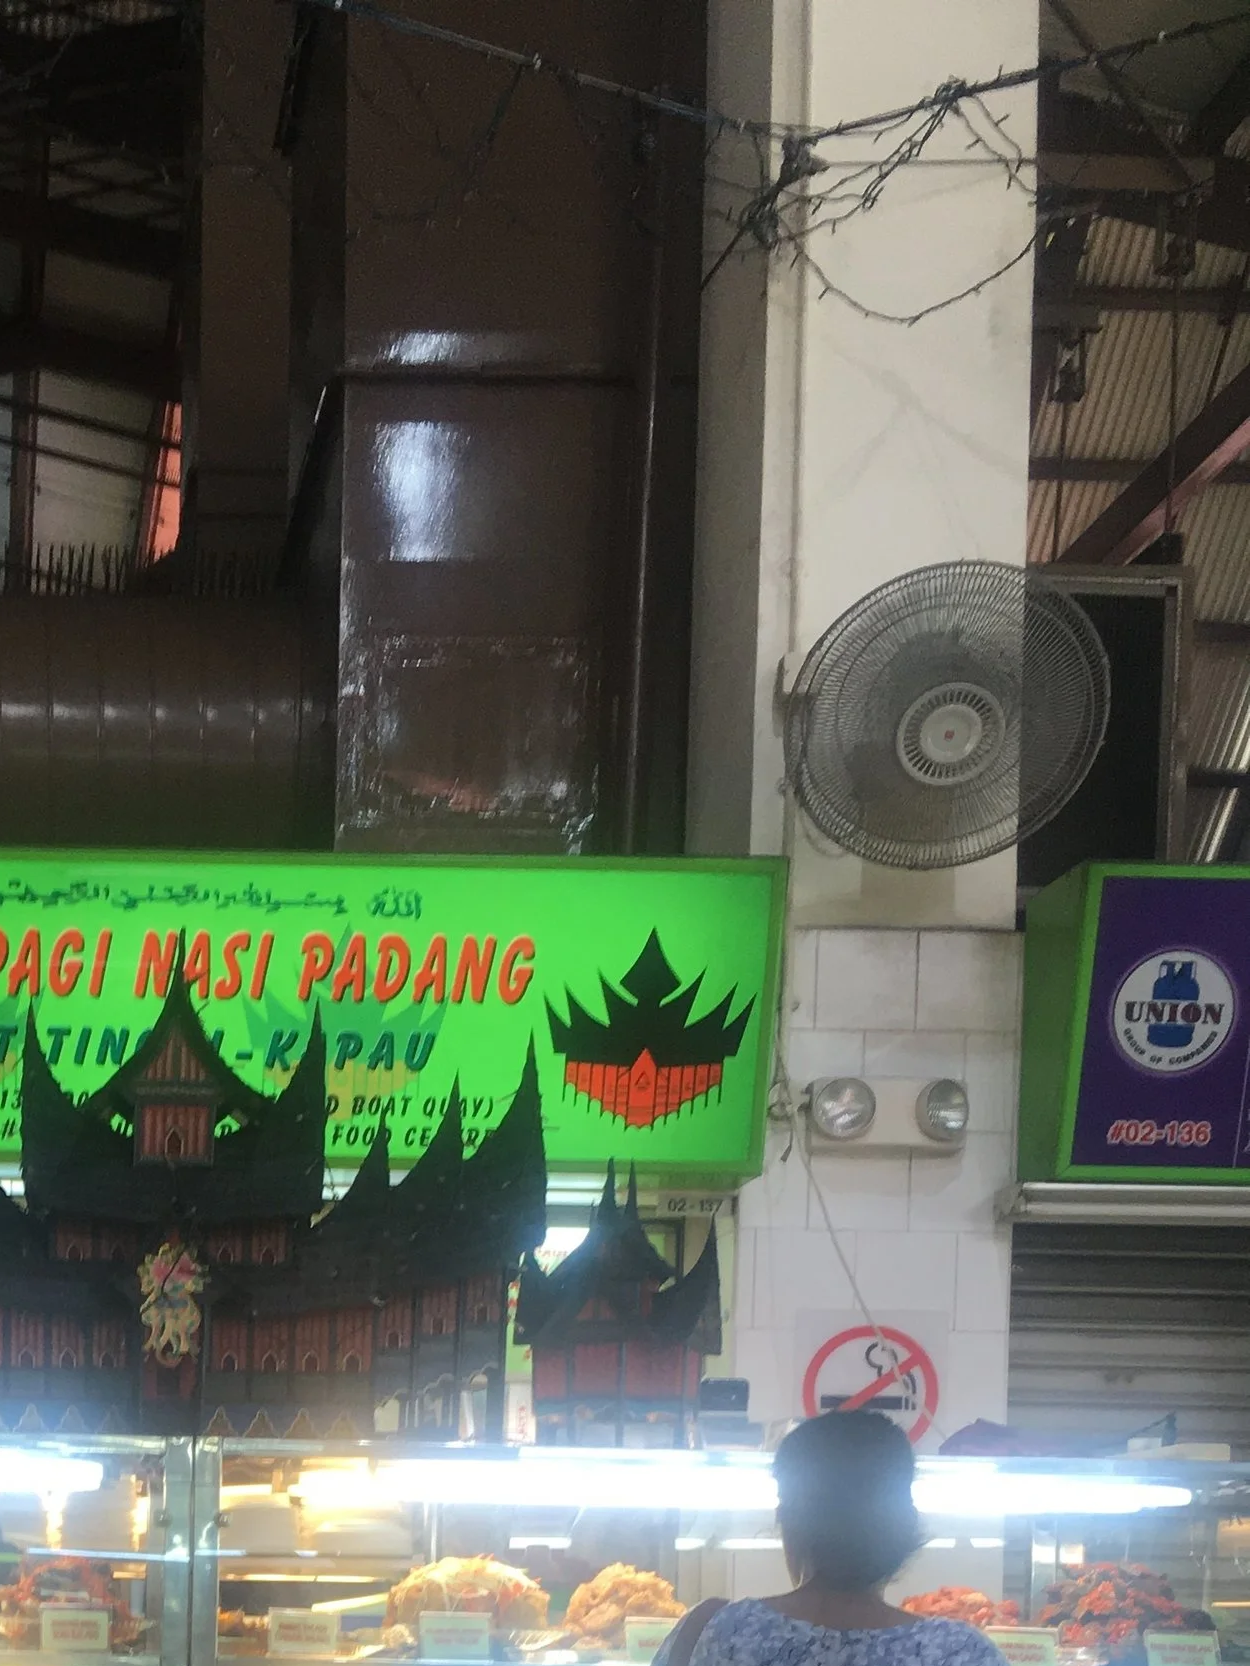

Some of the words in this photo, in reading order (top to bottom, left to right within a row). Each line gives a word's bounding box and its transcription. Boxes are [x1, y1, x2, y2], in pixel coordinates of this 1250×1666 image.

[134, 928, 275, 1002] NASI
[297, 931, 537, 1006] PADANG
[1125, 1001, 1225, 1025] UNION
[351, 1093, 412, 1117] BOAT
[1108, 1119, 1211, 1145] #02-136
